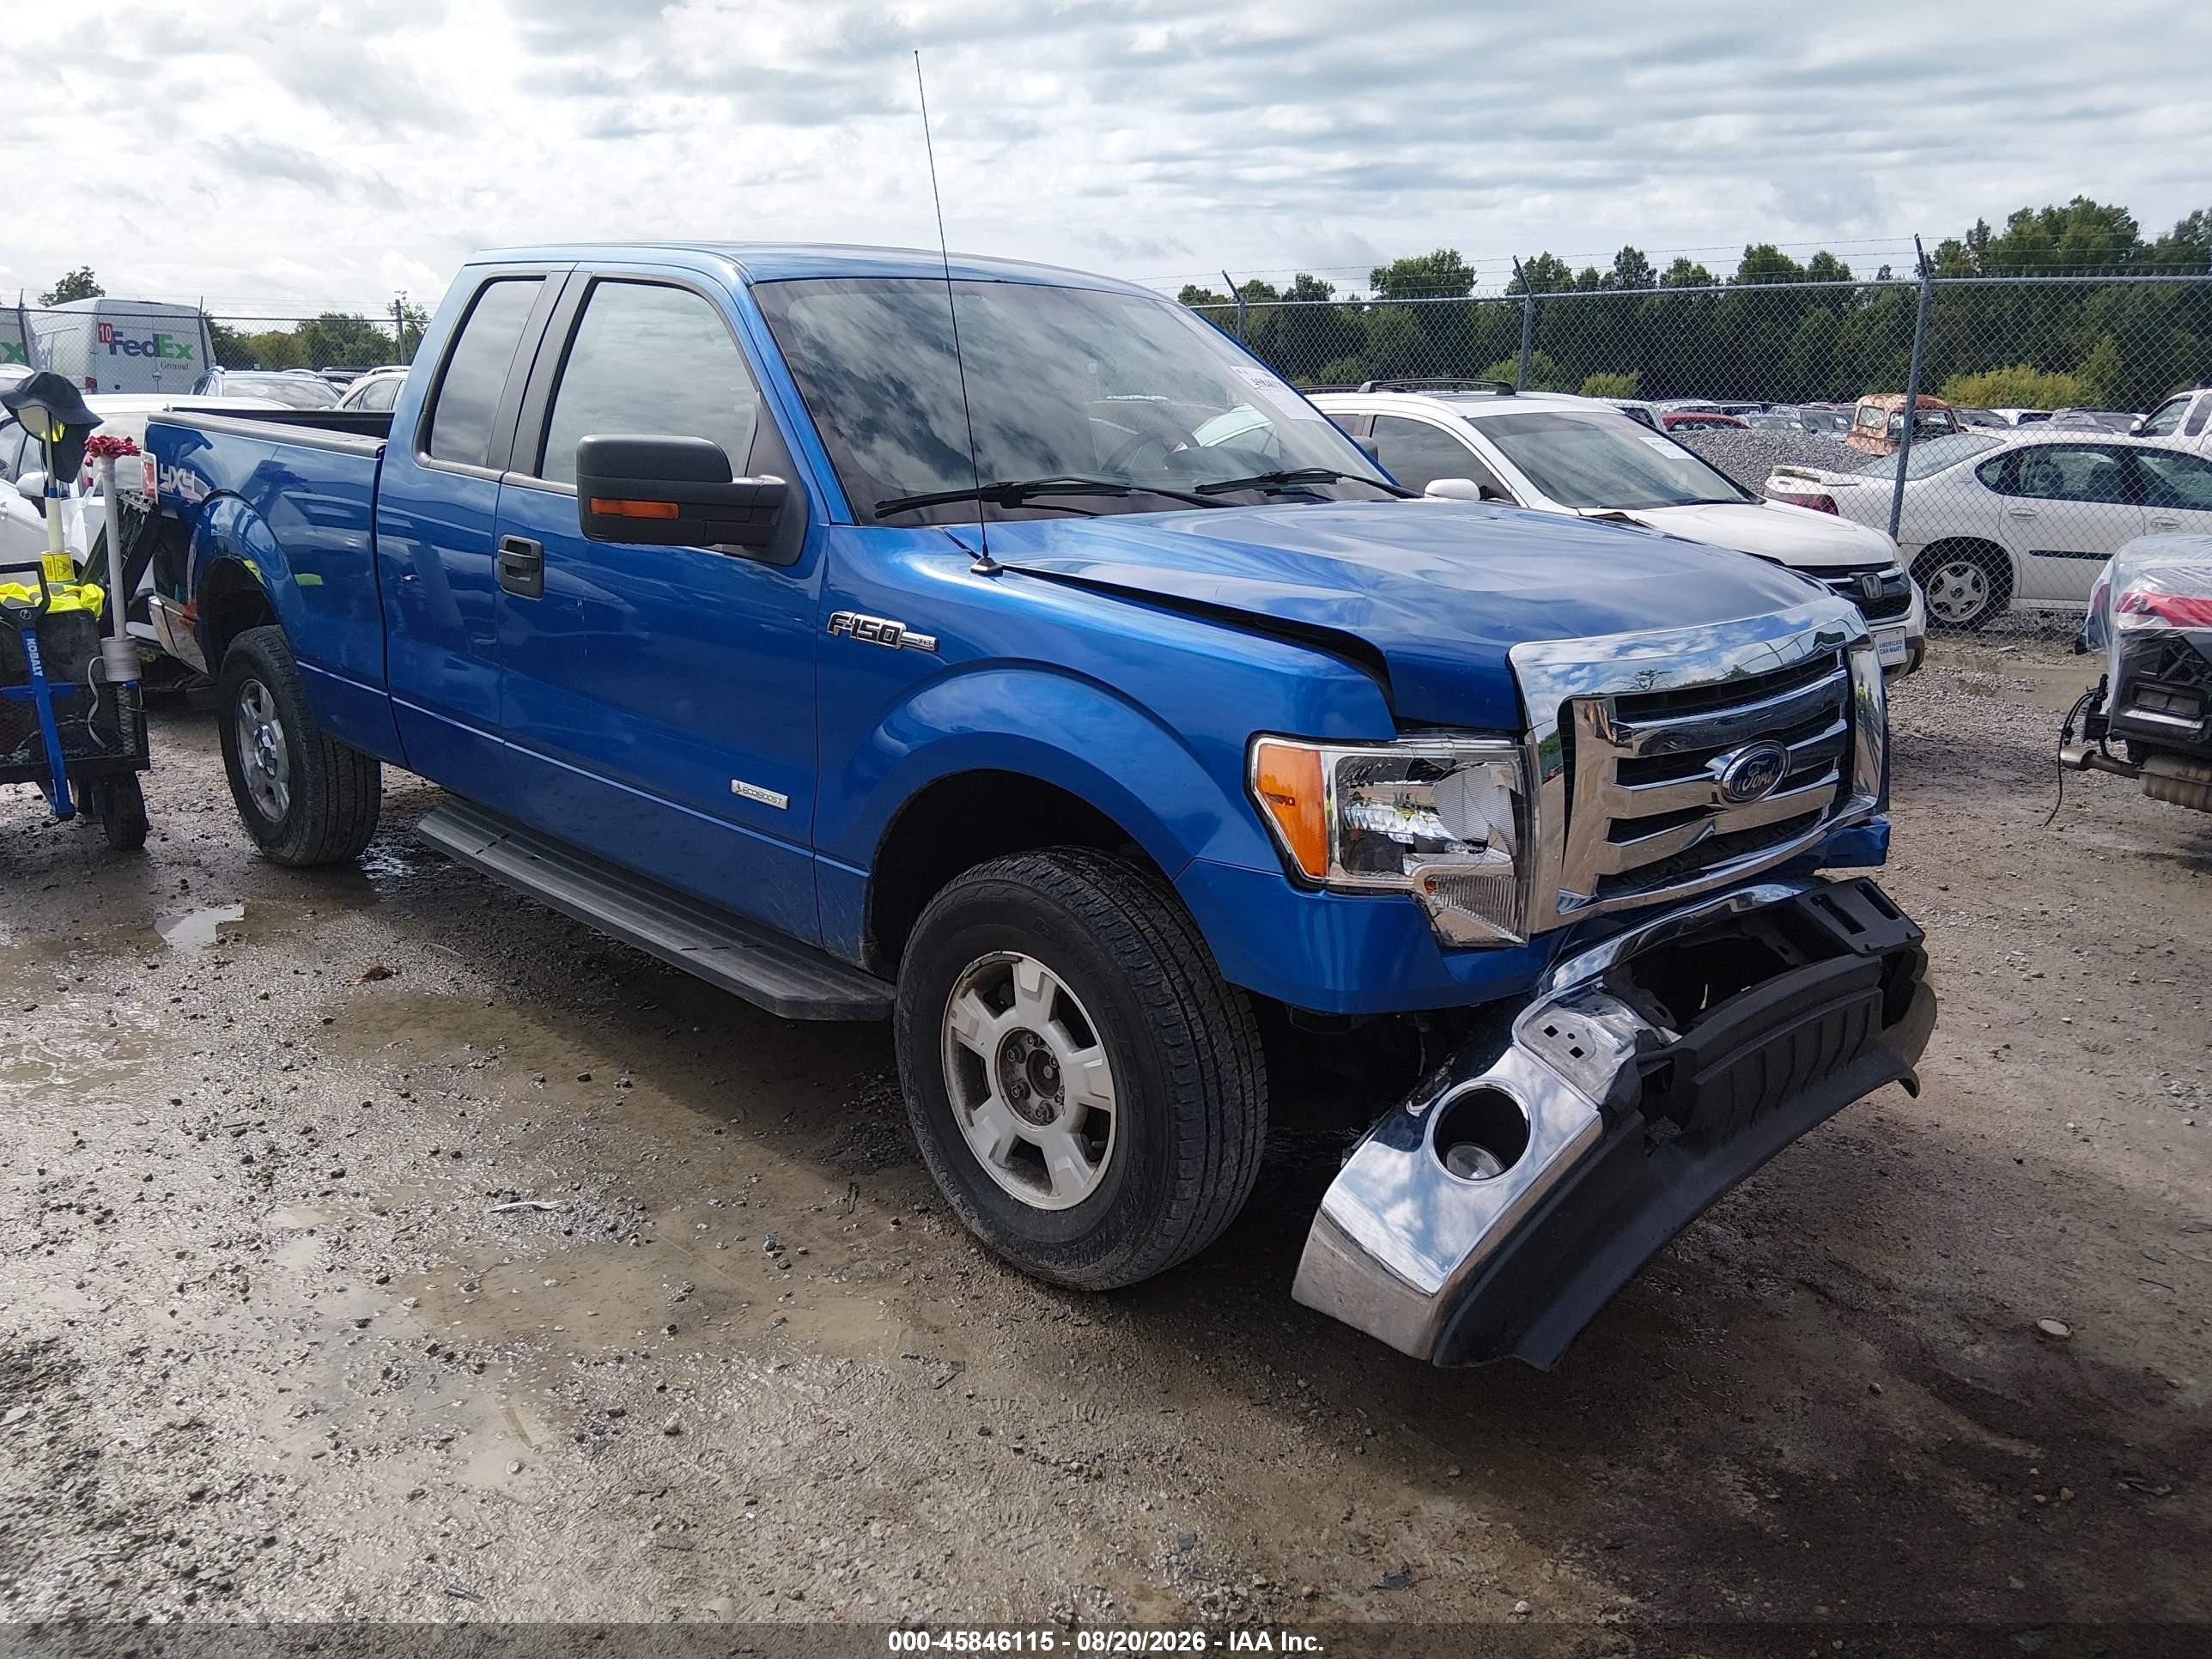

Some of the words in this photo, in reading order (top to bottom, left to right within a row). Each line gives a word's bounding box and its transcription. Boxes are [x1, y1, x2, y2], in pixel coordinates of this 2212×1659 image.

[99, 325, 112, 342] 10
[109, 331, 194, 360] FedEx
[26, 638, 44, 677] KOBALT
[1741, 759, 1777, 792] Ford
